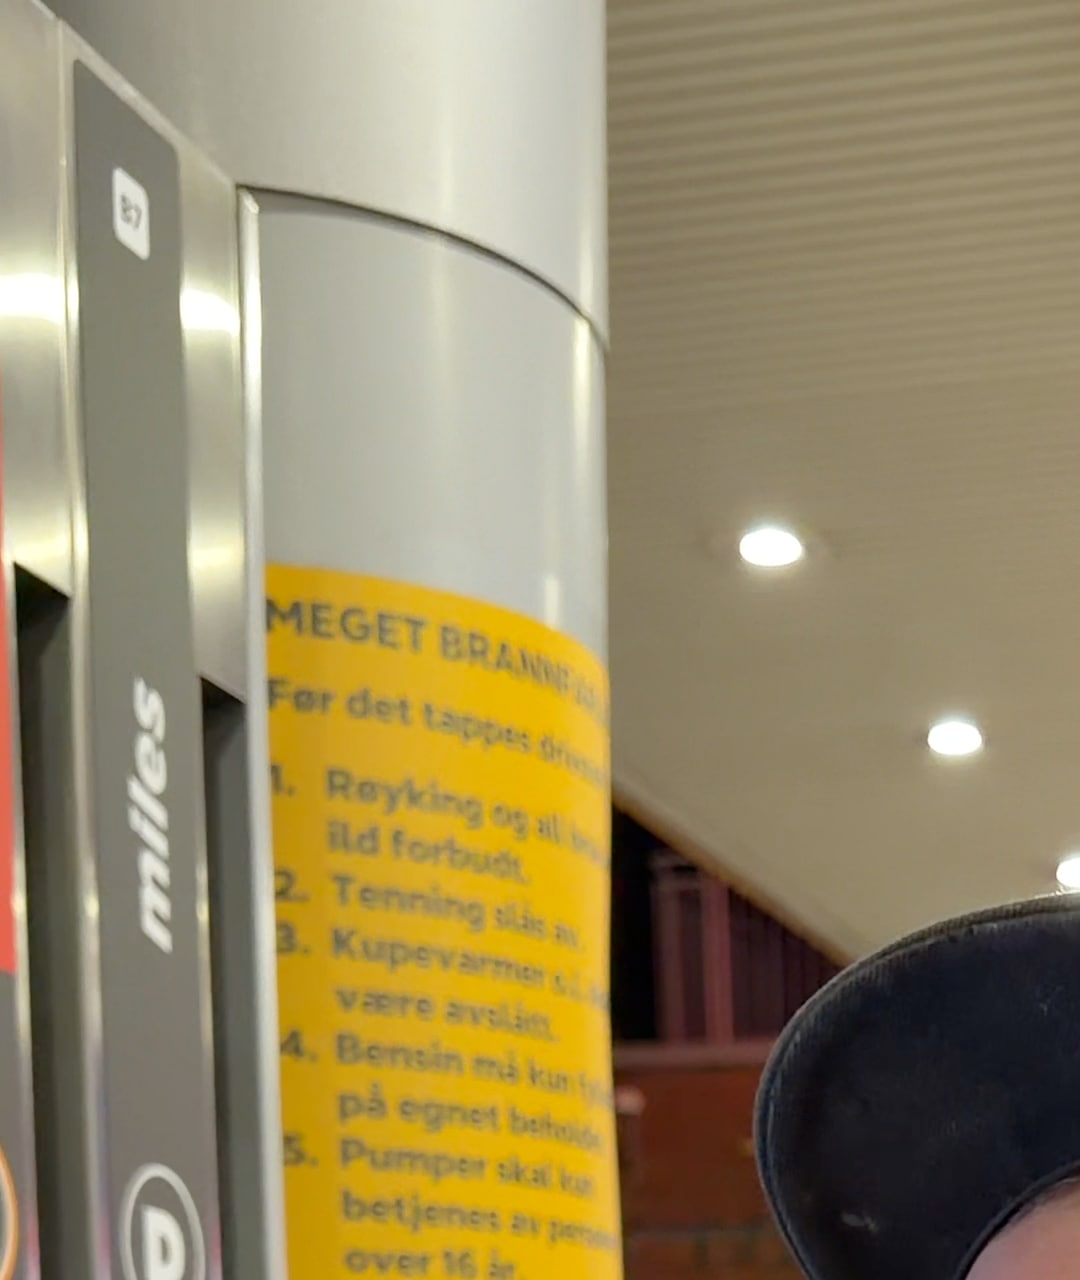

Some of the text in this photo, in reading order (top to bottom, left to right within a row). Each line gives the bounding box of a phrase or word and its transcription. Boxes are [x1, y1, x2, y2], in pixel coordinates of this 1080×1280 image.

[265, 598, 428, 652] MEGET
[346, 686, 413, 728] det
[127, 675, 174, 954] miles
[327, 768, 482, 830] Røyking
[328, 821, 381, 856] ild
[332, 875, 487, 933] Tenning
[336, 1032, 465, 1076] Bensin
[472, 1051, 519, 1085] må
[339, 1083, 387, 1125] på
[399, 1098, 499, 1134] egnet
[341, 1137, 487, 1184] Pumper
[342, 1188, 501, 1235] betjenes
[345, 1249, 430, 1276] over
[443, 1249, 477, 1280] 16
